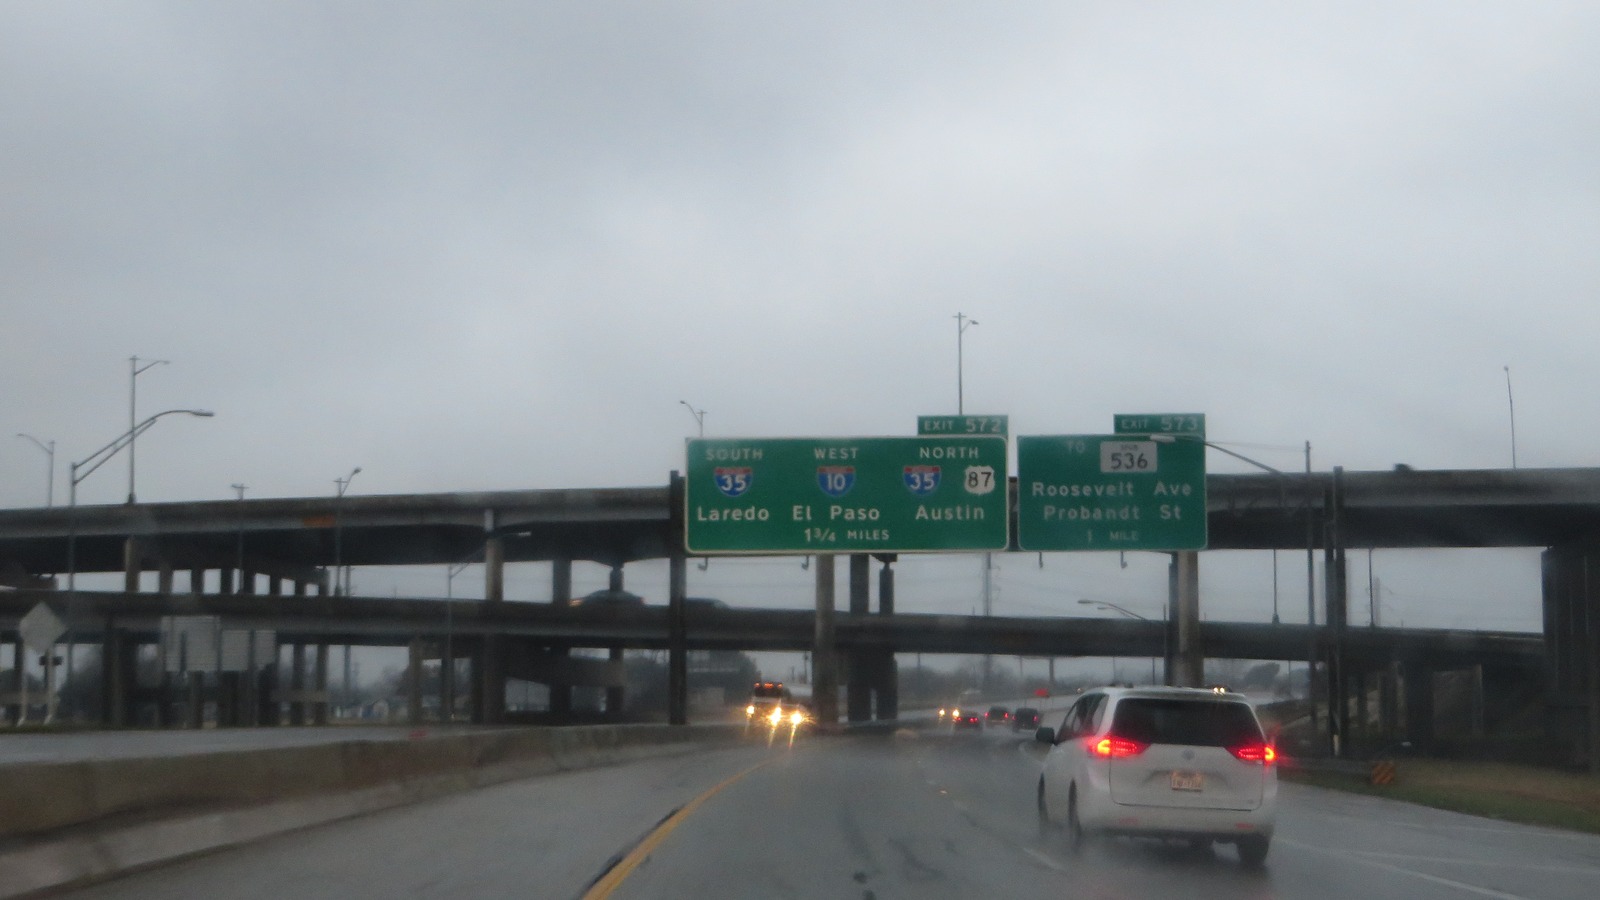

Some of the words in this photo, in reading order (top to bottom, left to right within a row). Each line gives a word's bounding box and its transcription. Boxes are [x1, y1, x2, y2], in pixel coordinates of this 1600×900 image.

[924, 421, 953, 431] EXIT
[966, 419, 1001, 432] 572
[1122, 419, 1148, 429] EXIT
[1161, 417, 1197, 431] 573
[706, 448, 763, 460] SOUTH
[814, 447, 859, 459] WEST
[919, 447, 979, 458] NORTH
[1110, 453, 1148, 469] 536
[721, 474, 747, 491] 35
[826, 474, 846, 490] 10
[910, 473, 935, 490] 35
[968, 472, 992, 488] 87
[1033, 481, 1134, 496] Roosevelt
[1154, 481, 1192, 496] Ave
[697, 505, 770, 521] Laredo
[792, 505, 812, 521] El
[830, 505, 880, 520] Paso
[915, 504, 985, 520] Austin
[1044, 505, 1140, 520] Probandt
[1160, 505, 1181, 520] St
[848, 530, 890, 540] MILES
[1110, 531, 1138, 541] MILE
